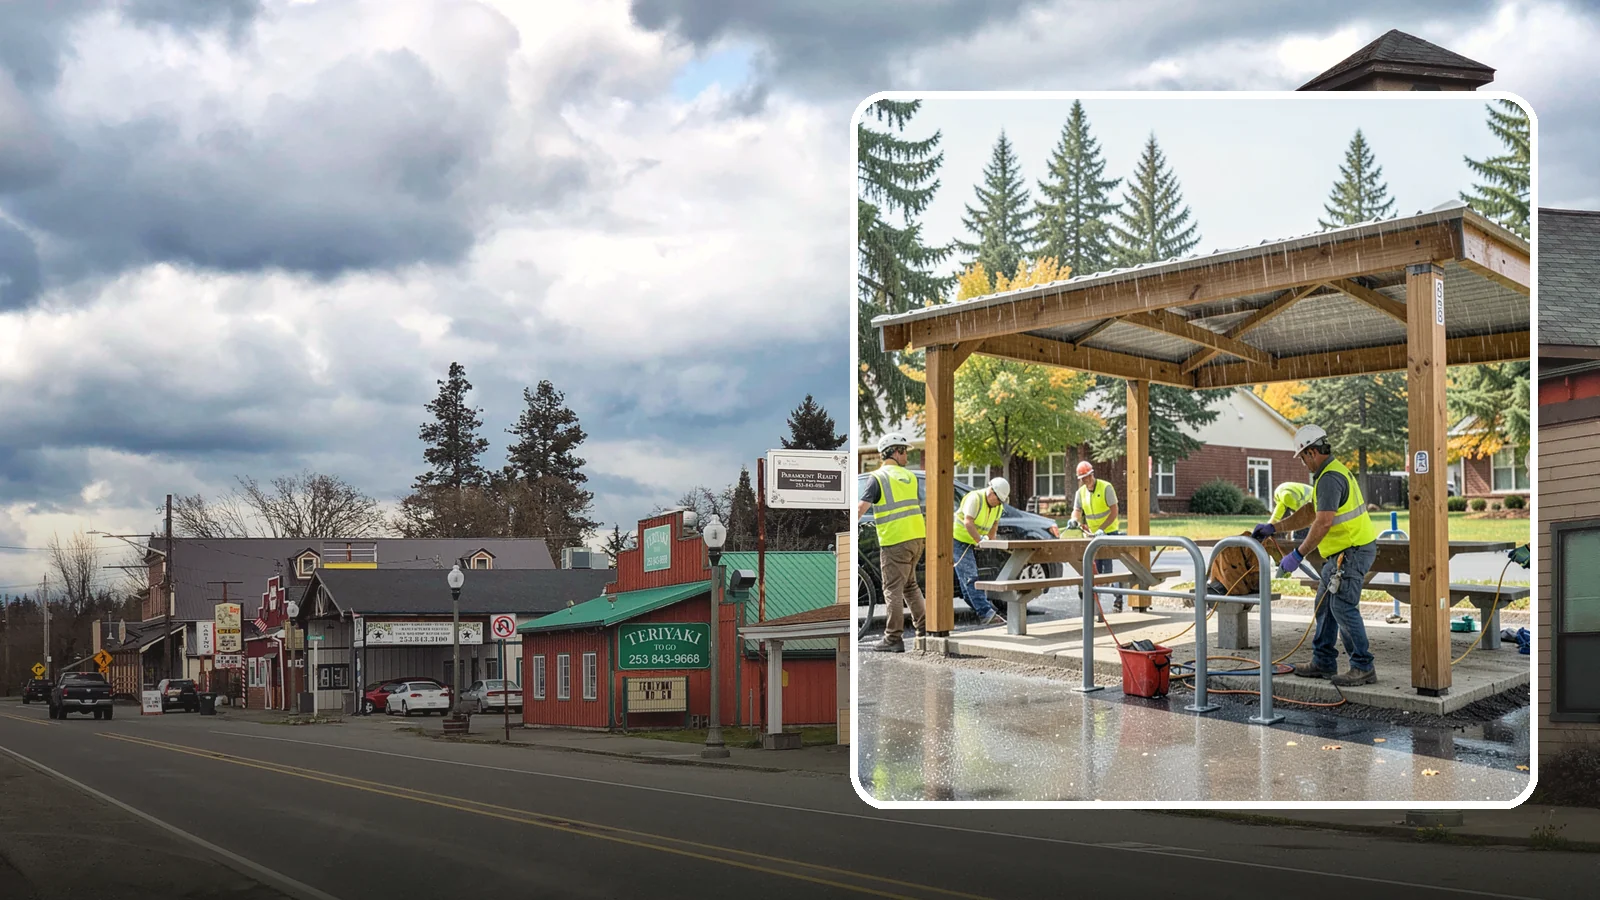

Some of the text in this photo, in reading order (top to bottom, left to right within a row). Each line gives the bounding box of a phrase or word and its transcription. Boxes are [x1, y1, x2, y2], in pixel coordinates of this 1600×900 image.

[781, 471, 839, 480] PARAMOUNT REALTY
[624, 627, 703, 646] TERIYAKI
[628, 654, 700, 665] 253 843-9668
